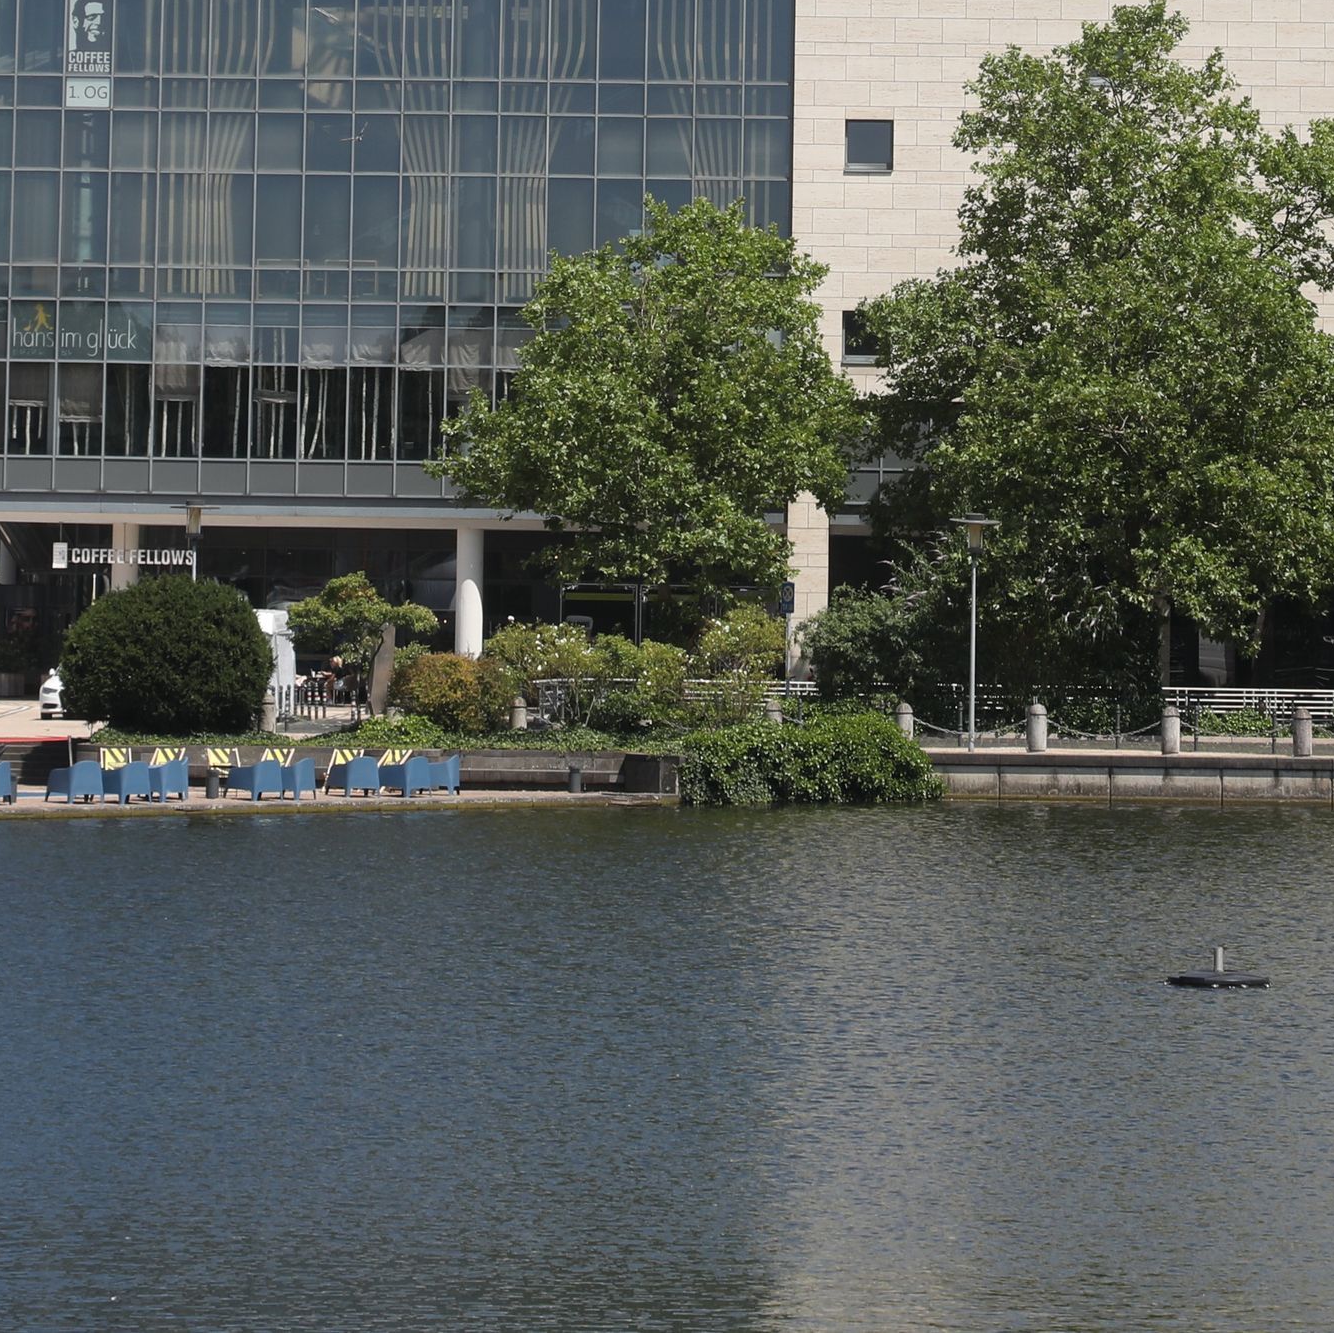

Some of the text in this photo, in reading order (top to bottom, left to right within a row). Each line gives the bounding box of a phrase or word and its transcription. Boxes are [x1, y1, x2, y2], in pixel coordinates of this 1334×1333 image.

[68, 51, 110, 64] COFFEE
[68, 64, 110, 72] FELLOWS
[69, 85, 108, 99] 1. OG
[13, 318, 137, 357] hans im glück
[71, 547, 193, 565] COFFEE FELLOWS
